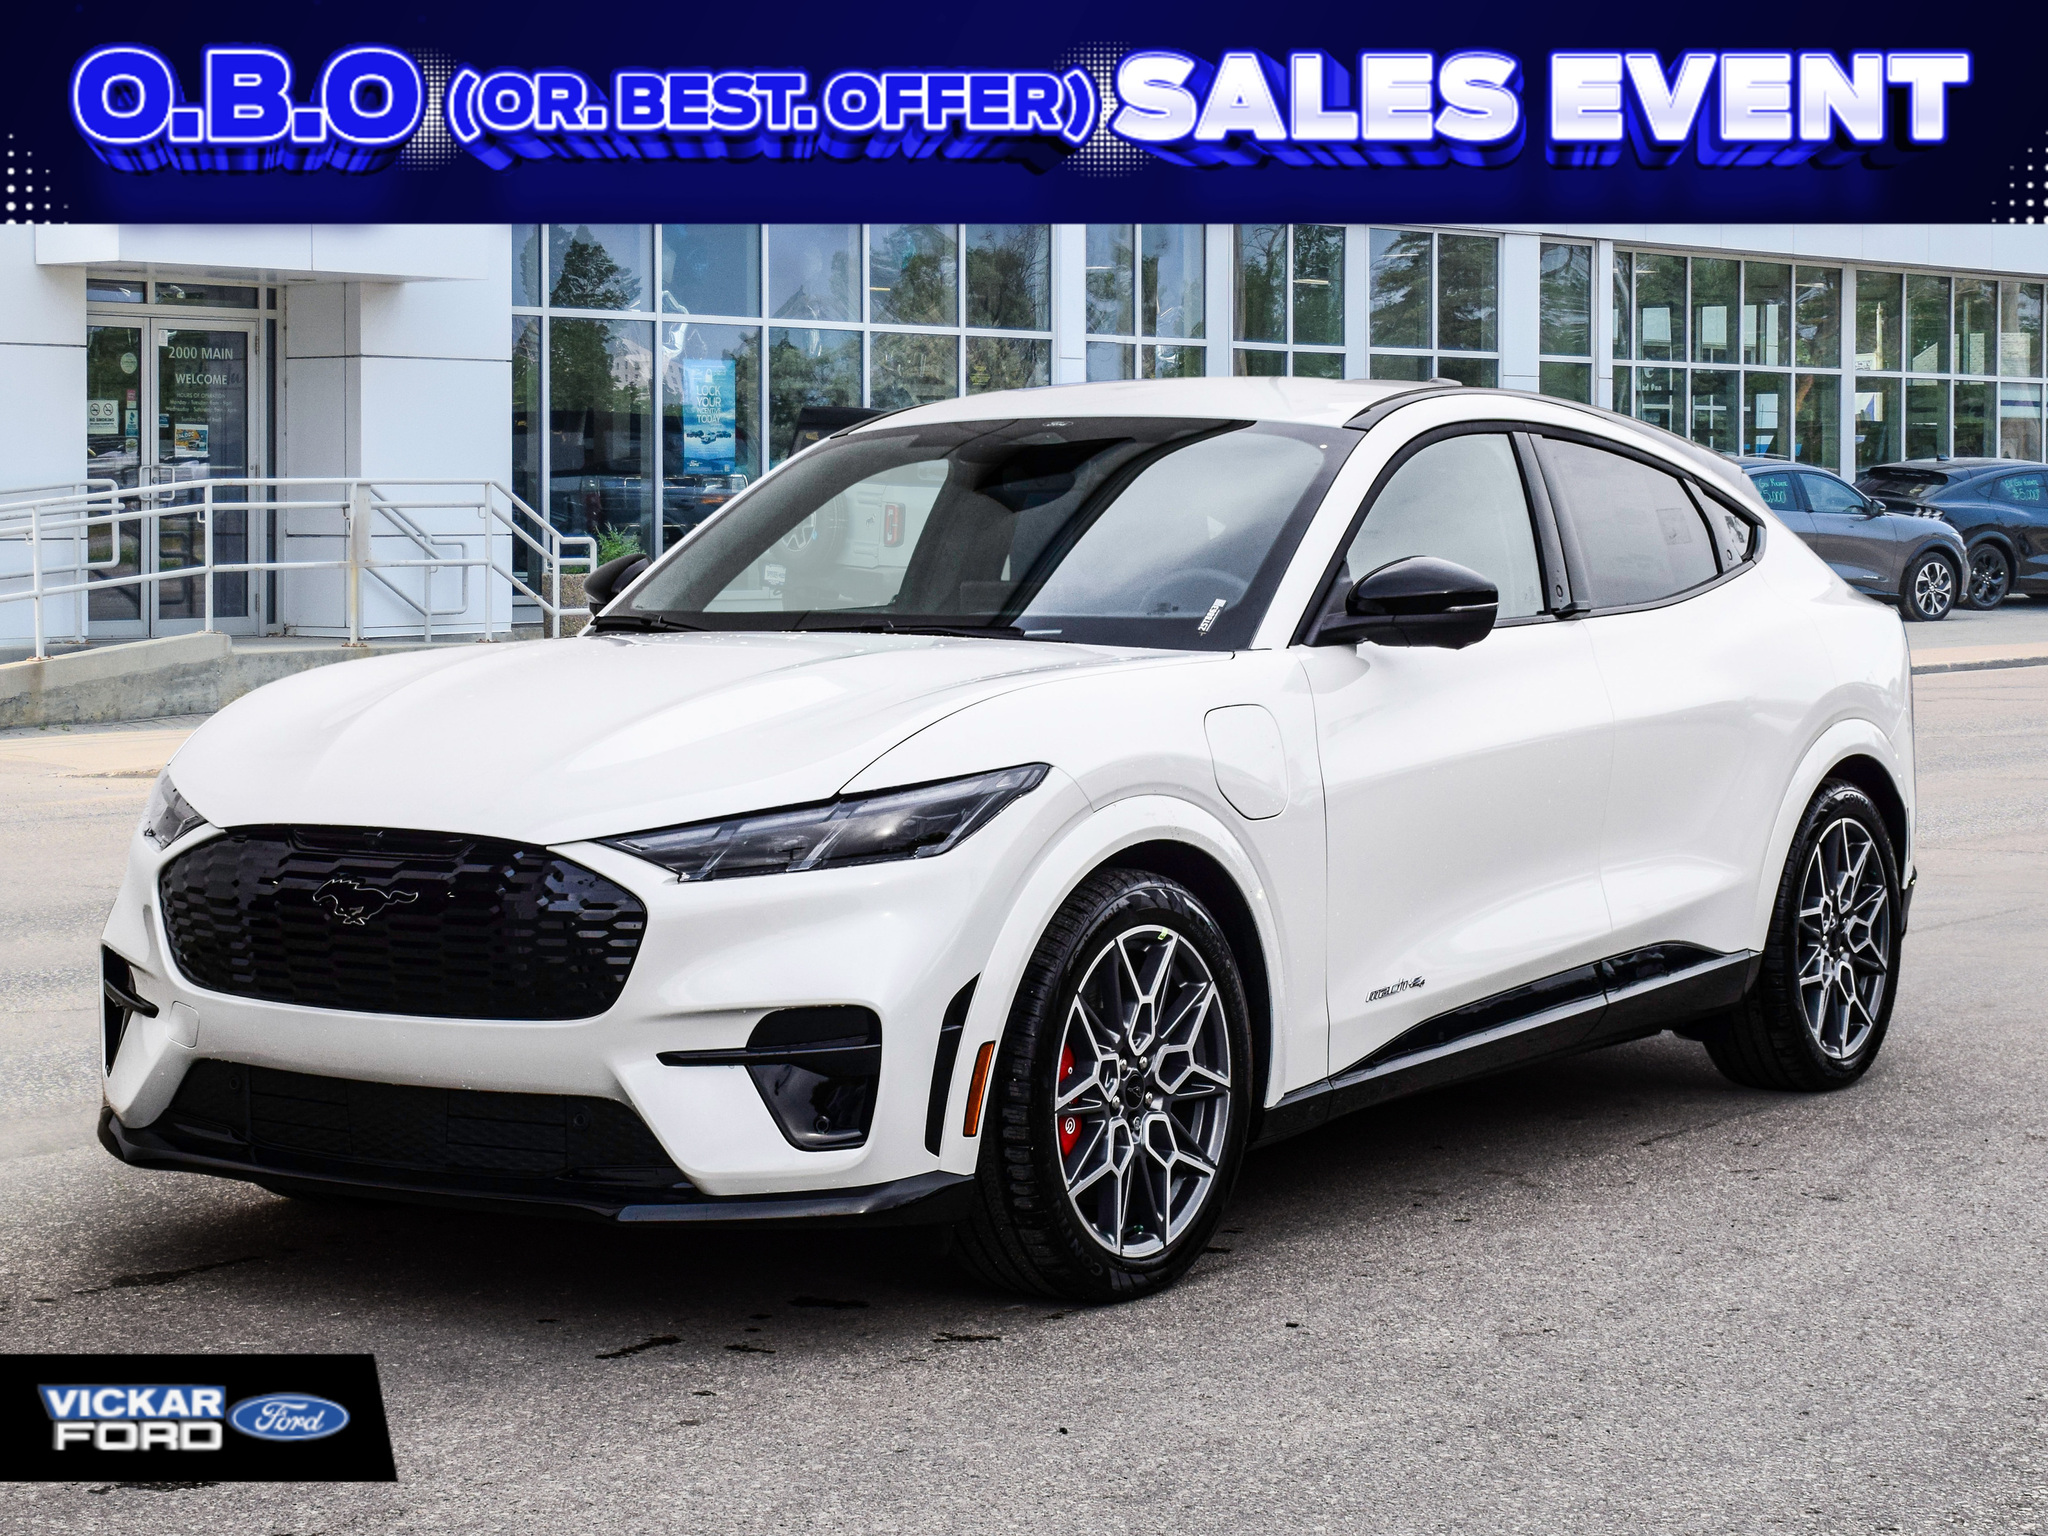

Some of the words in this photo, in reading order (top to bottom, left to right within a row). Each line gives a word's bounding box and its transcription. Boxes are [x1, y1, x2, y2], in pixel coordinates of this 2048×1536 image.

[168, 346, 198, 359] 2000
[201, 347, 234, 360] MAIN
[175, 373, 228, 386] WELCOME
[696, 384, 721, 396] LOCK
[696, 396, 722, 408] YOUR
[697, 414, 721, 424] TODAY
